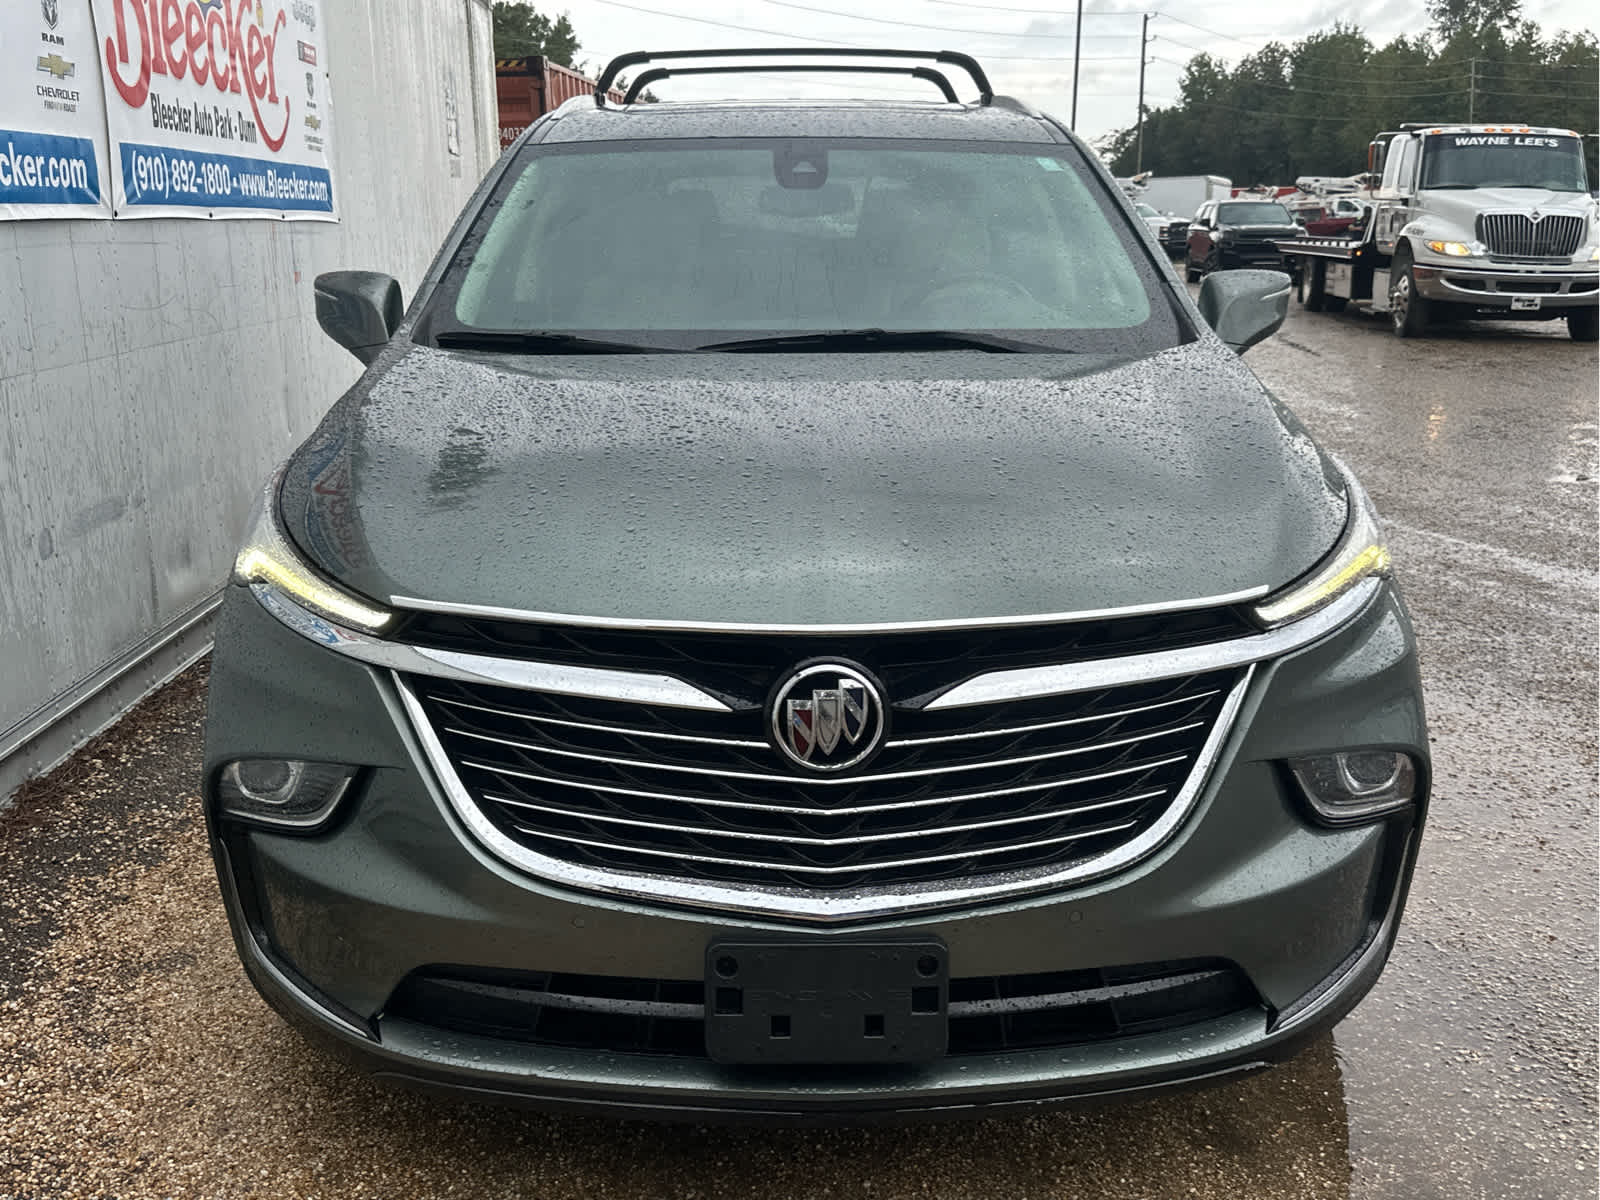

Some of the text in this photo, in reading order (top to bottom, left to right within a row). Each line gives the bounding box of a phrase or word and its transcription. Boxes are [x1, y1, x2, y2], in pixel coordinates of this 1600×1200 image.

[41, 32, 64, 46] RAM
[36, 85, 80, 102] CHEVROLET
[150, 92, 192, 133] Bleecker
[194, 101, 213, 137] Auto
[213, 105, 234, 140] Park
[238, 111, 257, 144] Dunn
[1455, 136, 1559, 148] WAYNE LEE'S
[0, 141, 88, 189] cker.com
[131, 150, 170, 199] (910)
[171, 158, 231, 196] 892-1800
[239, 168, 329, 201] www.Bleecker.com
